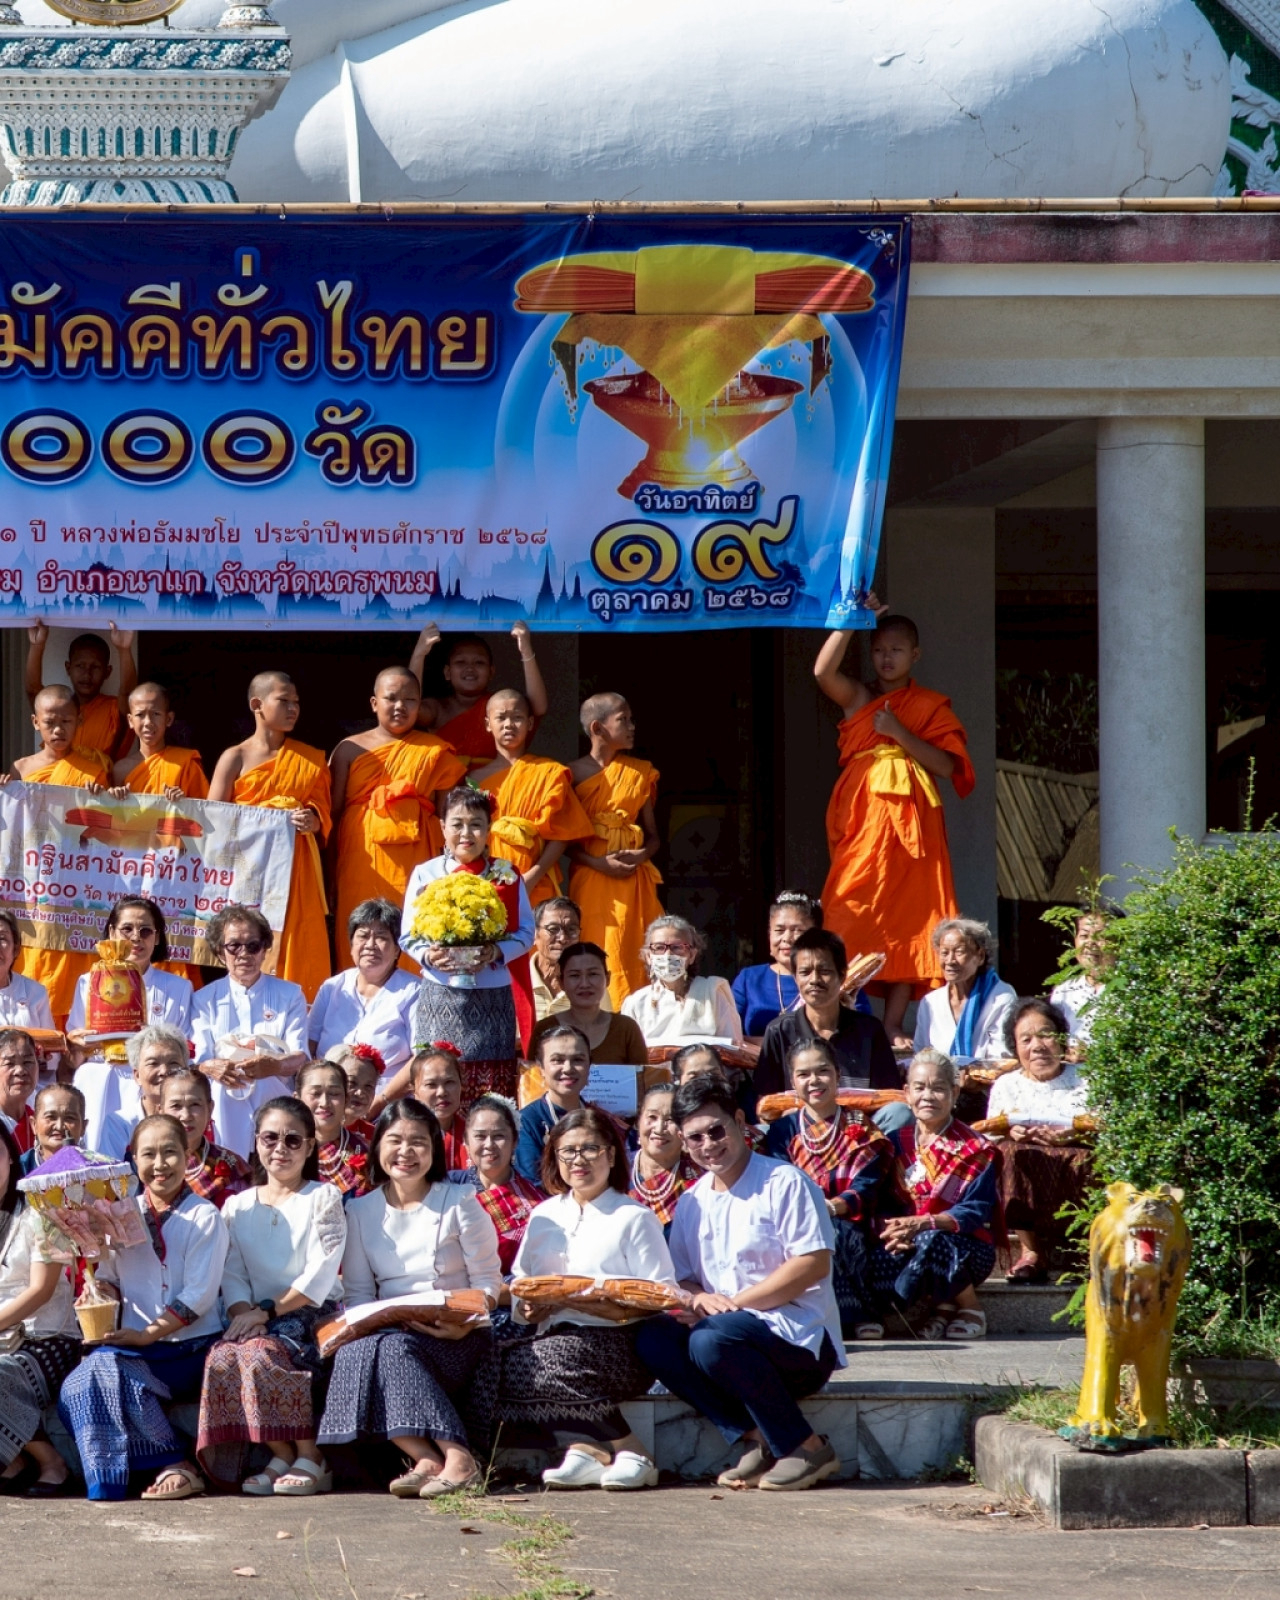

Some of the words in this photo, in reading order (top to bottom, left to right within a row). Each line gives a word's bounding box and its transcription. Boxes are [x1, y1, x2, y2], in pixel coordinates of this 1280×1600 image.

[637, 486, 757, 510] วันอาทิตย์
[29, 519, 47, 543] ปี
[61, 517, 241, 544] หลวงพ่อธัมมชโย
[255, 520, 465, 552] ประจำปีพุทธศักราช
[478, 526, 548, 545] ๒๕๖๘
[593, 497, 798, 583] ๑๙
[37, 559, 205, 594] อำเภอนาแก
[216, 560, 438, 597] จังหวัดนครพนม
[592, 588, 690, 619] ตุลาคม
[707, 586, 792, 608] ๒๕๖๘
[25, 844, 235, 887] กฐินสามัคคีทั่วไทย
[83, 884, 102, 901] วัด
[194, 894, 261, 913] ๒๕
